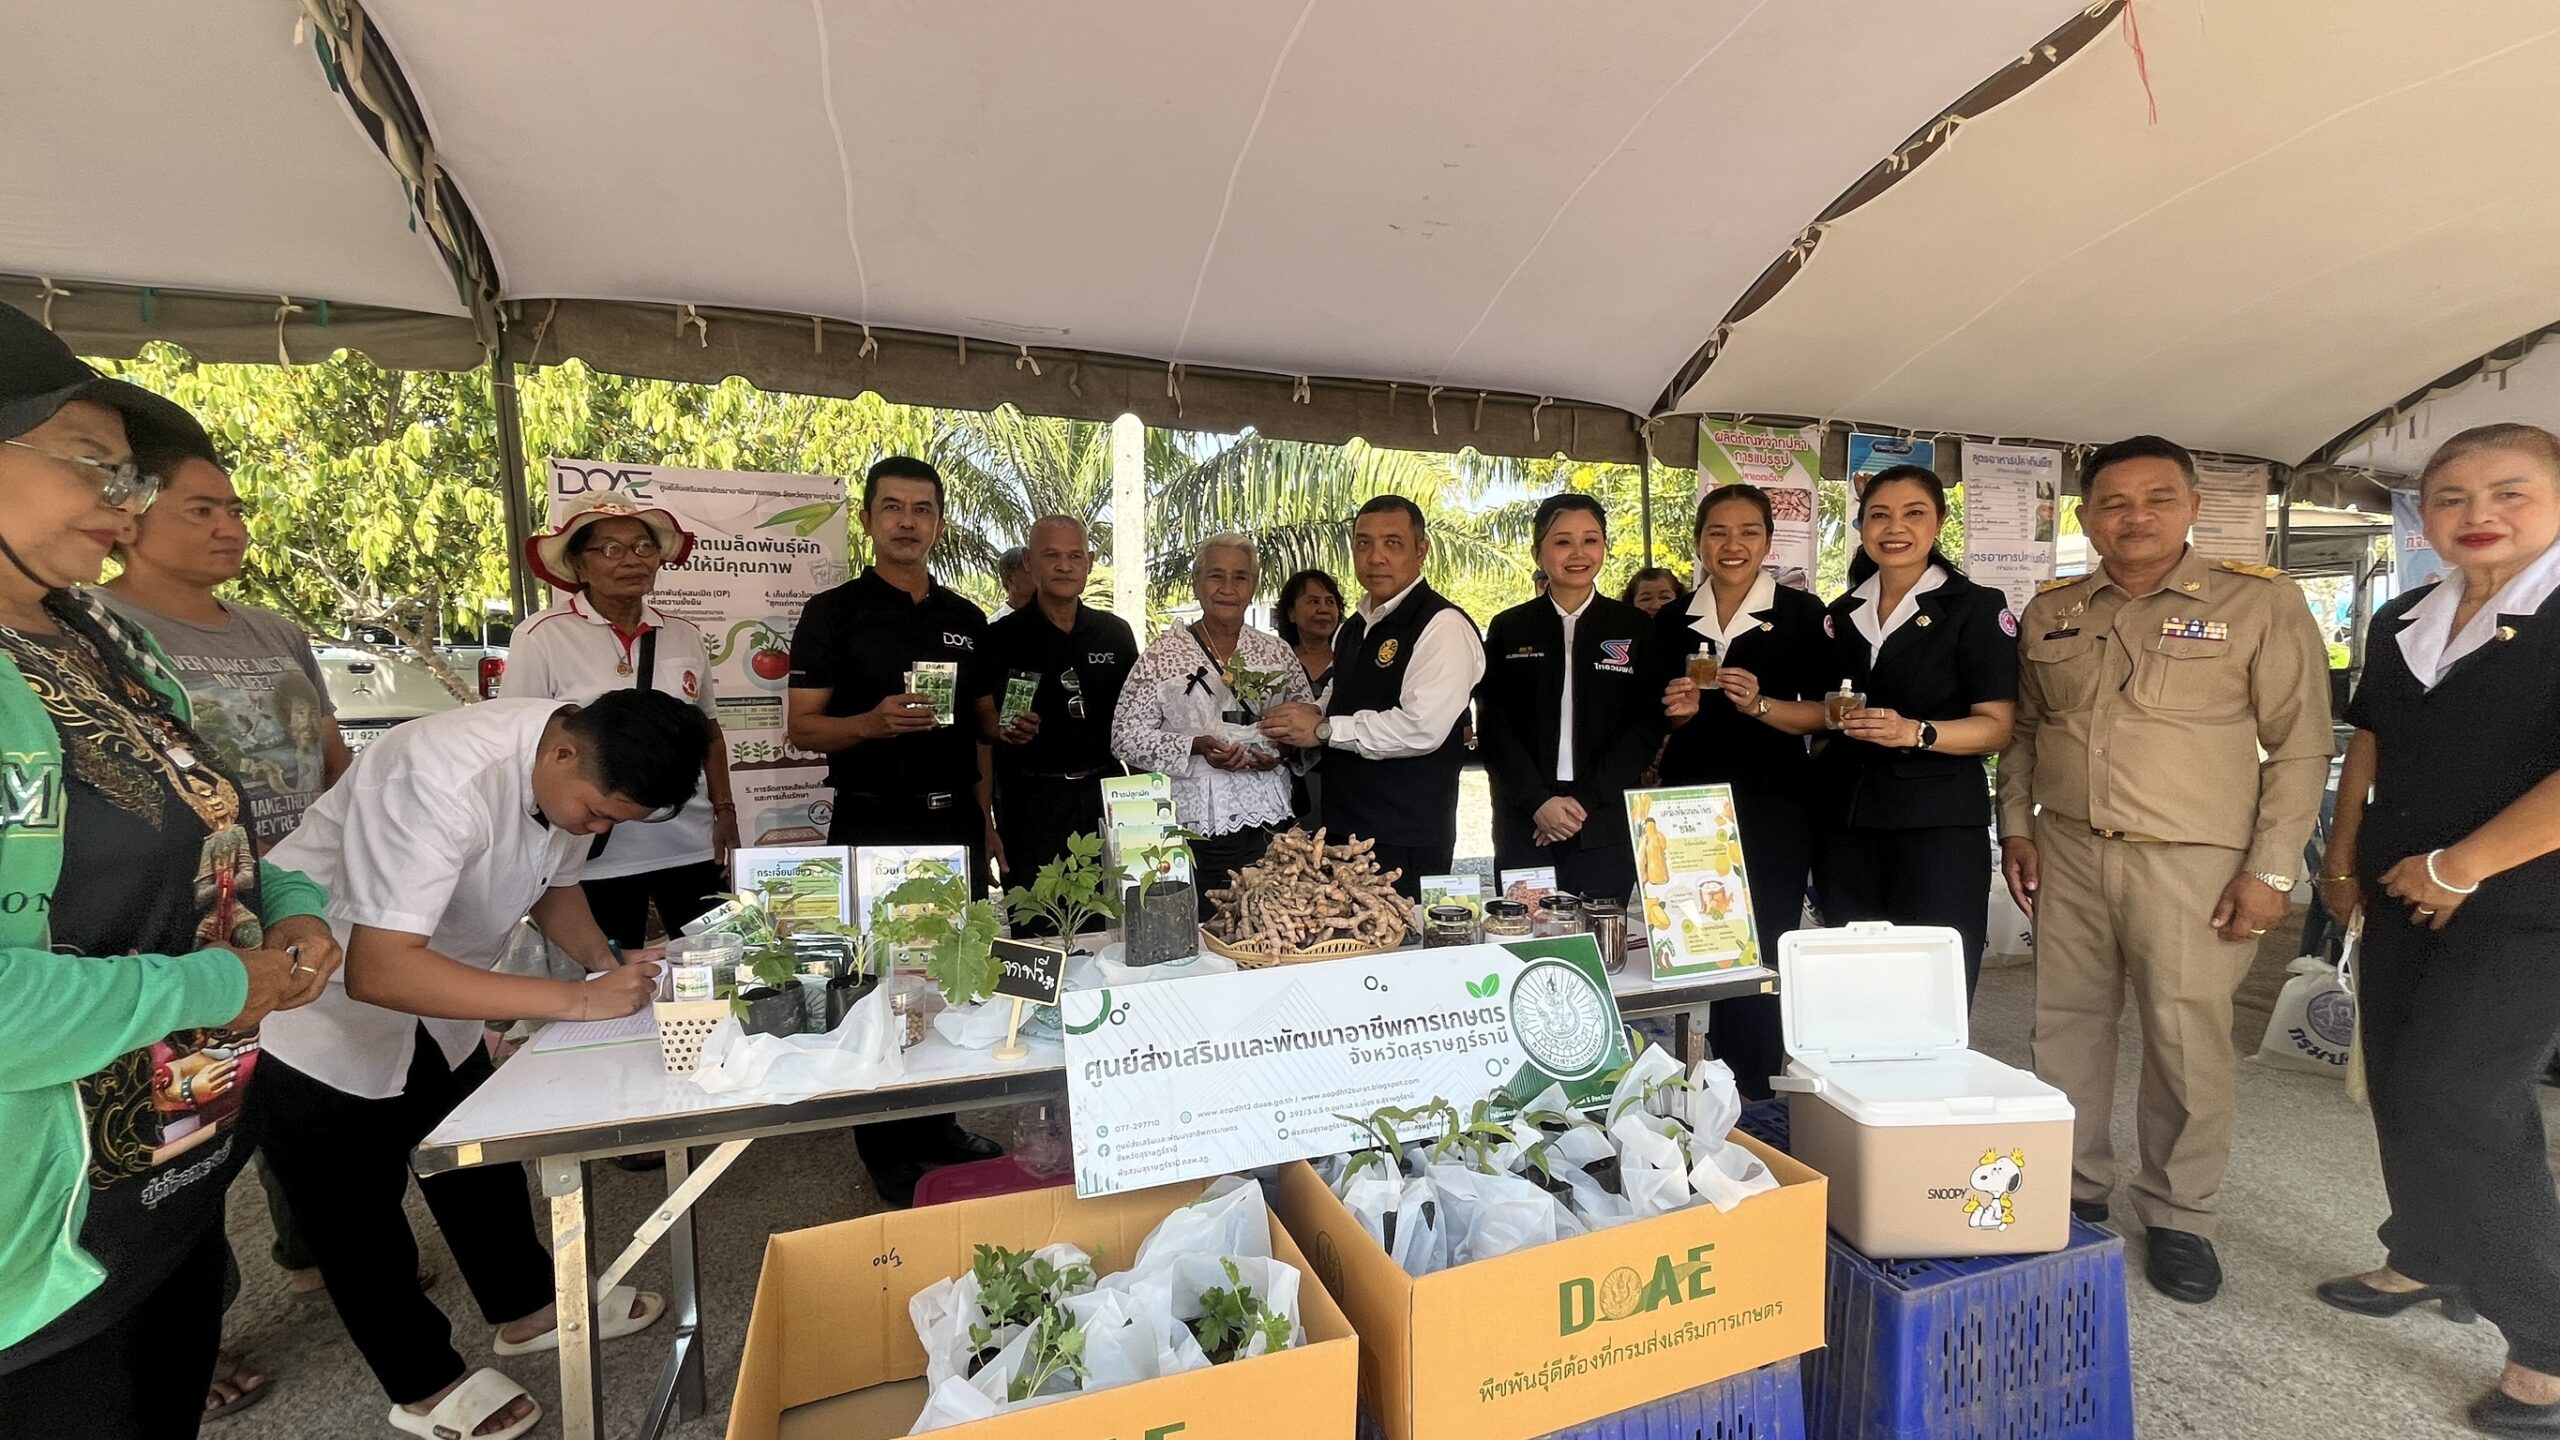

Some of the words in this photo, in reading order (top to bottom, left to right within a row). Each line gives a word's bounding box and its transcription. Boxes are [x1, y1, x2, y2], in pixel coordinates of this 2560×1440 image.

[1714, 430, 1808, 450] ผลิตภัณฑ์จากปลา
[1734, 451, 1790, 469] การแปรรูป
[1084, 1006, 1506, 1087] ศูนย์ส่งเสริมและพัฒนาอาชีพการเกษตร
[1349, 1026, 1509, 1065] จังหวัดสุราษฎร์ธานี
[1115, 1119, 1160, 1133] 077-297710
[1928, 1188, 1966, 1200] SNOOPY
[1479, 1300, 1784, 1403] พืชพันธุ์ดีต้องที่กรมส่งเสริมการเกษตร
